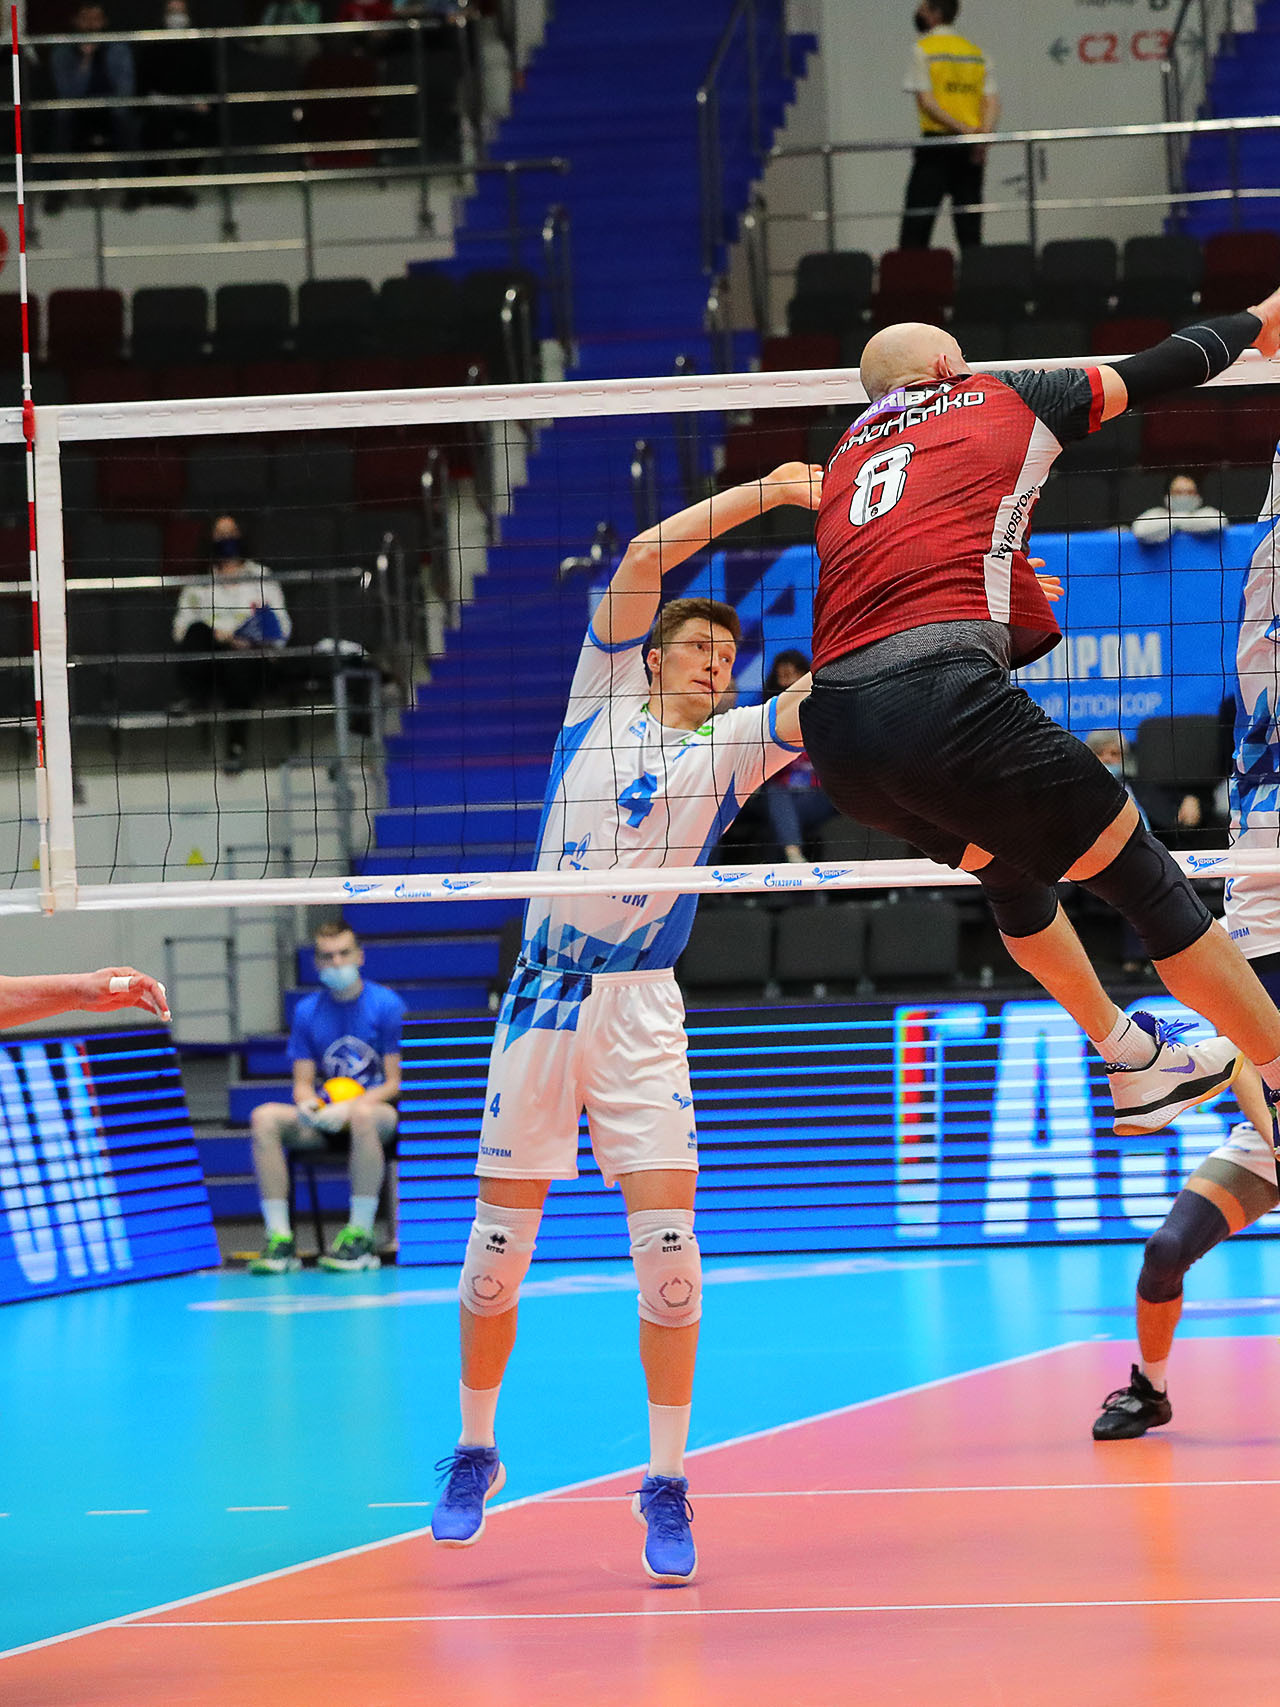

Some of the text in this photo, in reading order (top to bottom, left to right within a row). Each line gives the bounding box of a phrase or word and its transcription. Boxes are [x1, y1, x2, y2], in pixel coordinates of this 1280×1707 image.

[849, 442, 916, 527] 8
[618, 772, 658, 829] 4
[489, 1092, 501, 1118] 4
